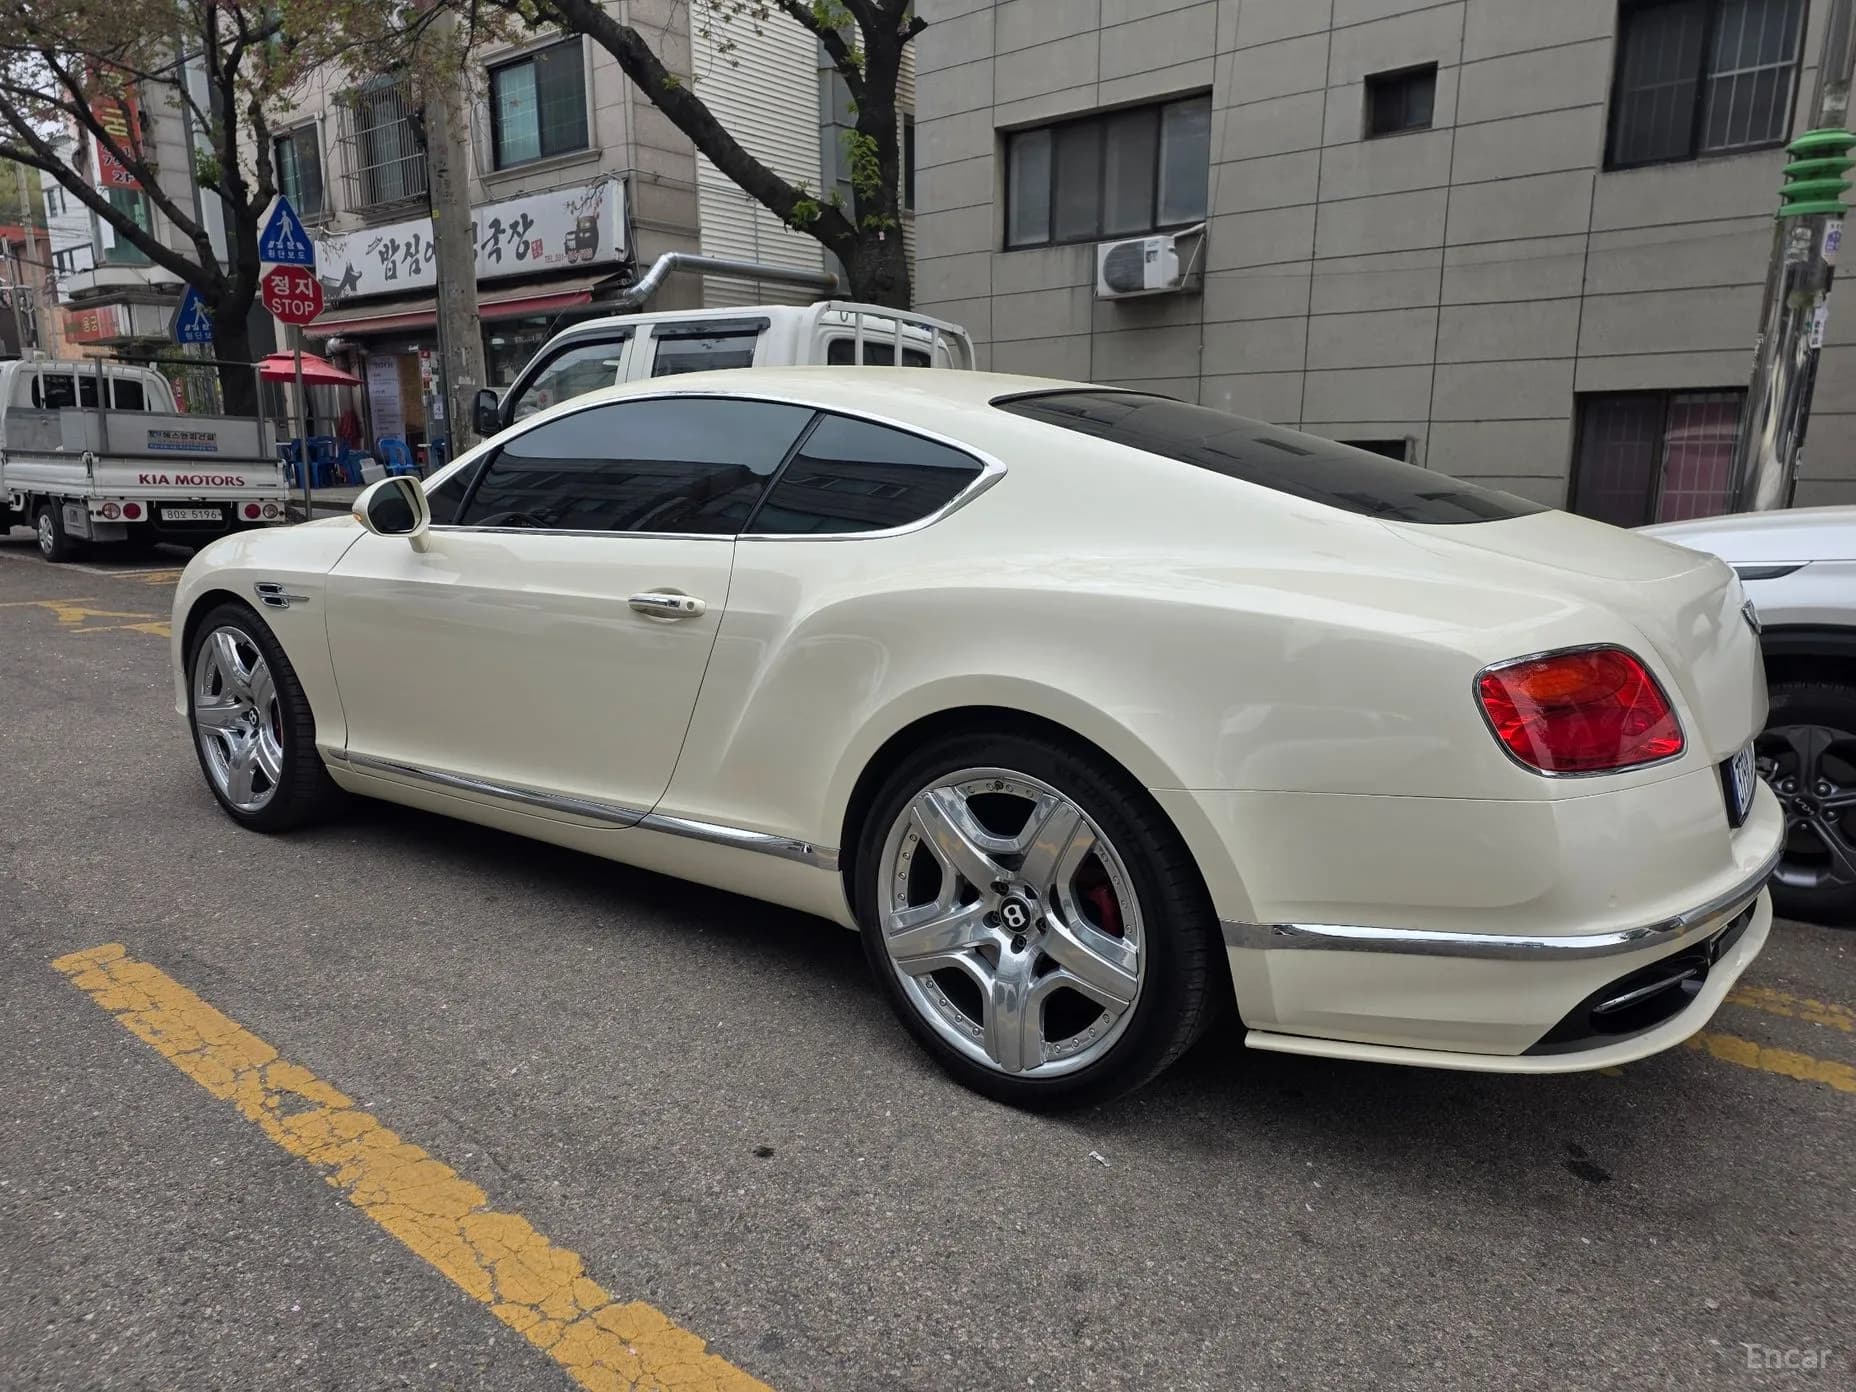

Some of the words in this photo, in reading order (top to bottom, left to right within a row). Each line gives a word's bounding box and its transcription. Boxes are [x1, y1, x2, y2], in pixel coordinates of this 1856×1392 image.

[268, 249, 305, 259] 횡단보도
[271, 275, 314, 298] 정지
[272, 298, 314, 316] STOP
[139, 474, 170, 485] KIA
[175, 474, 245, 487] MOTORS
[192, 511, 217, 519] 5196
